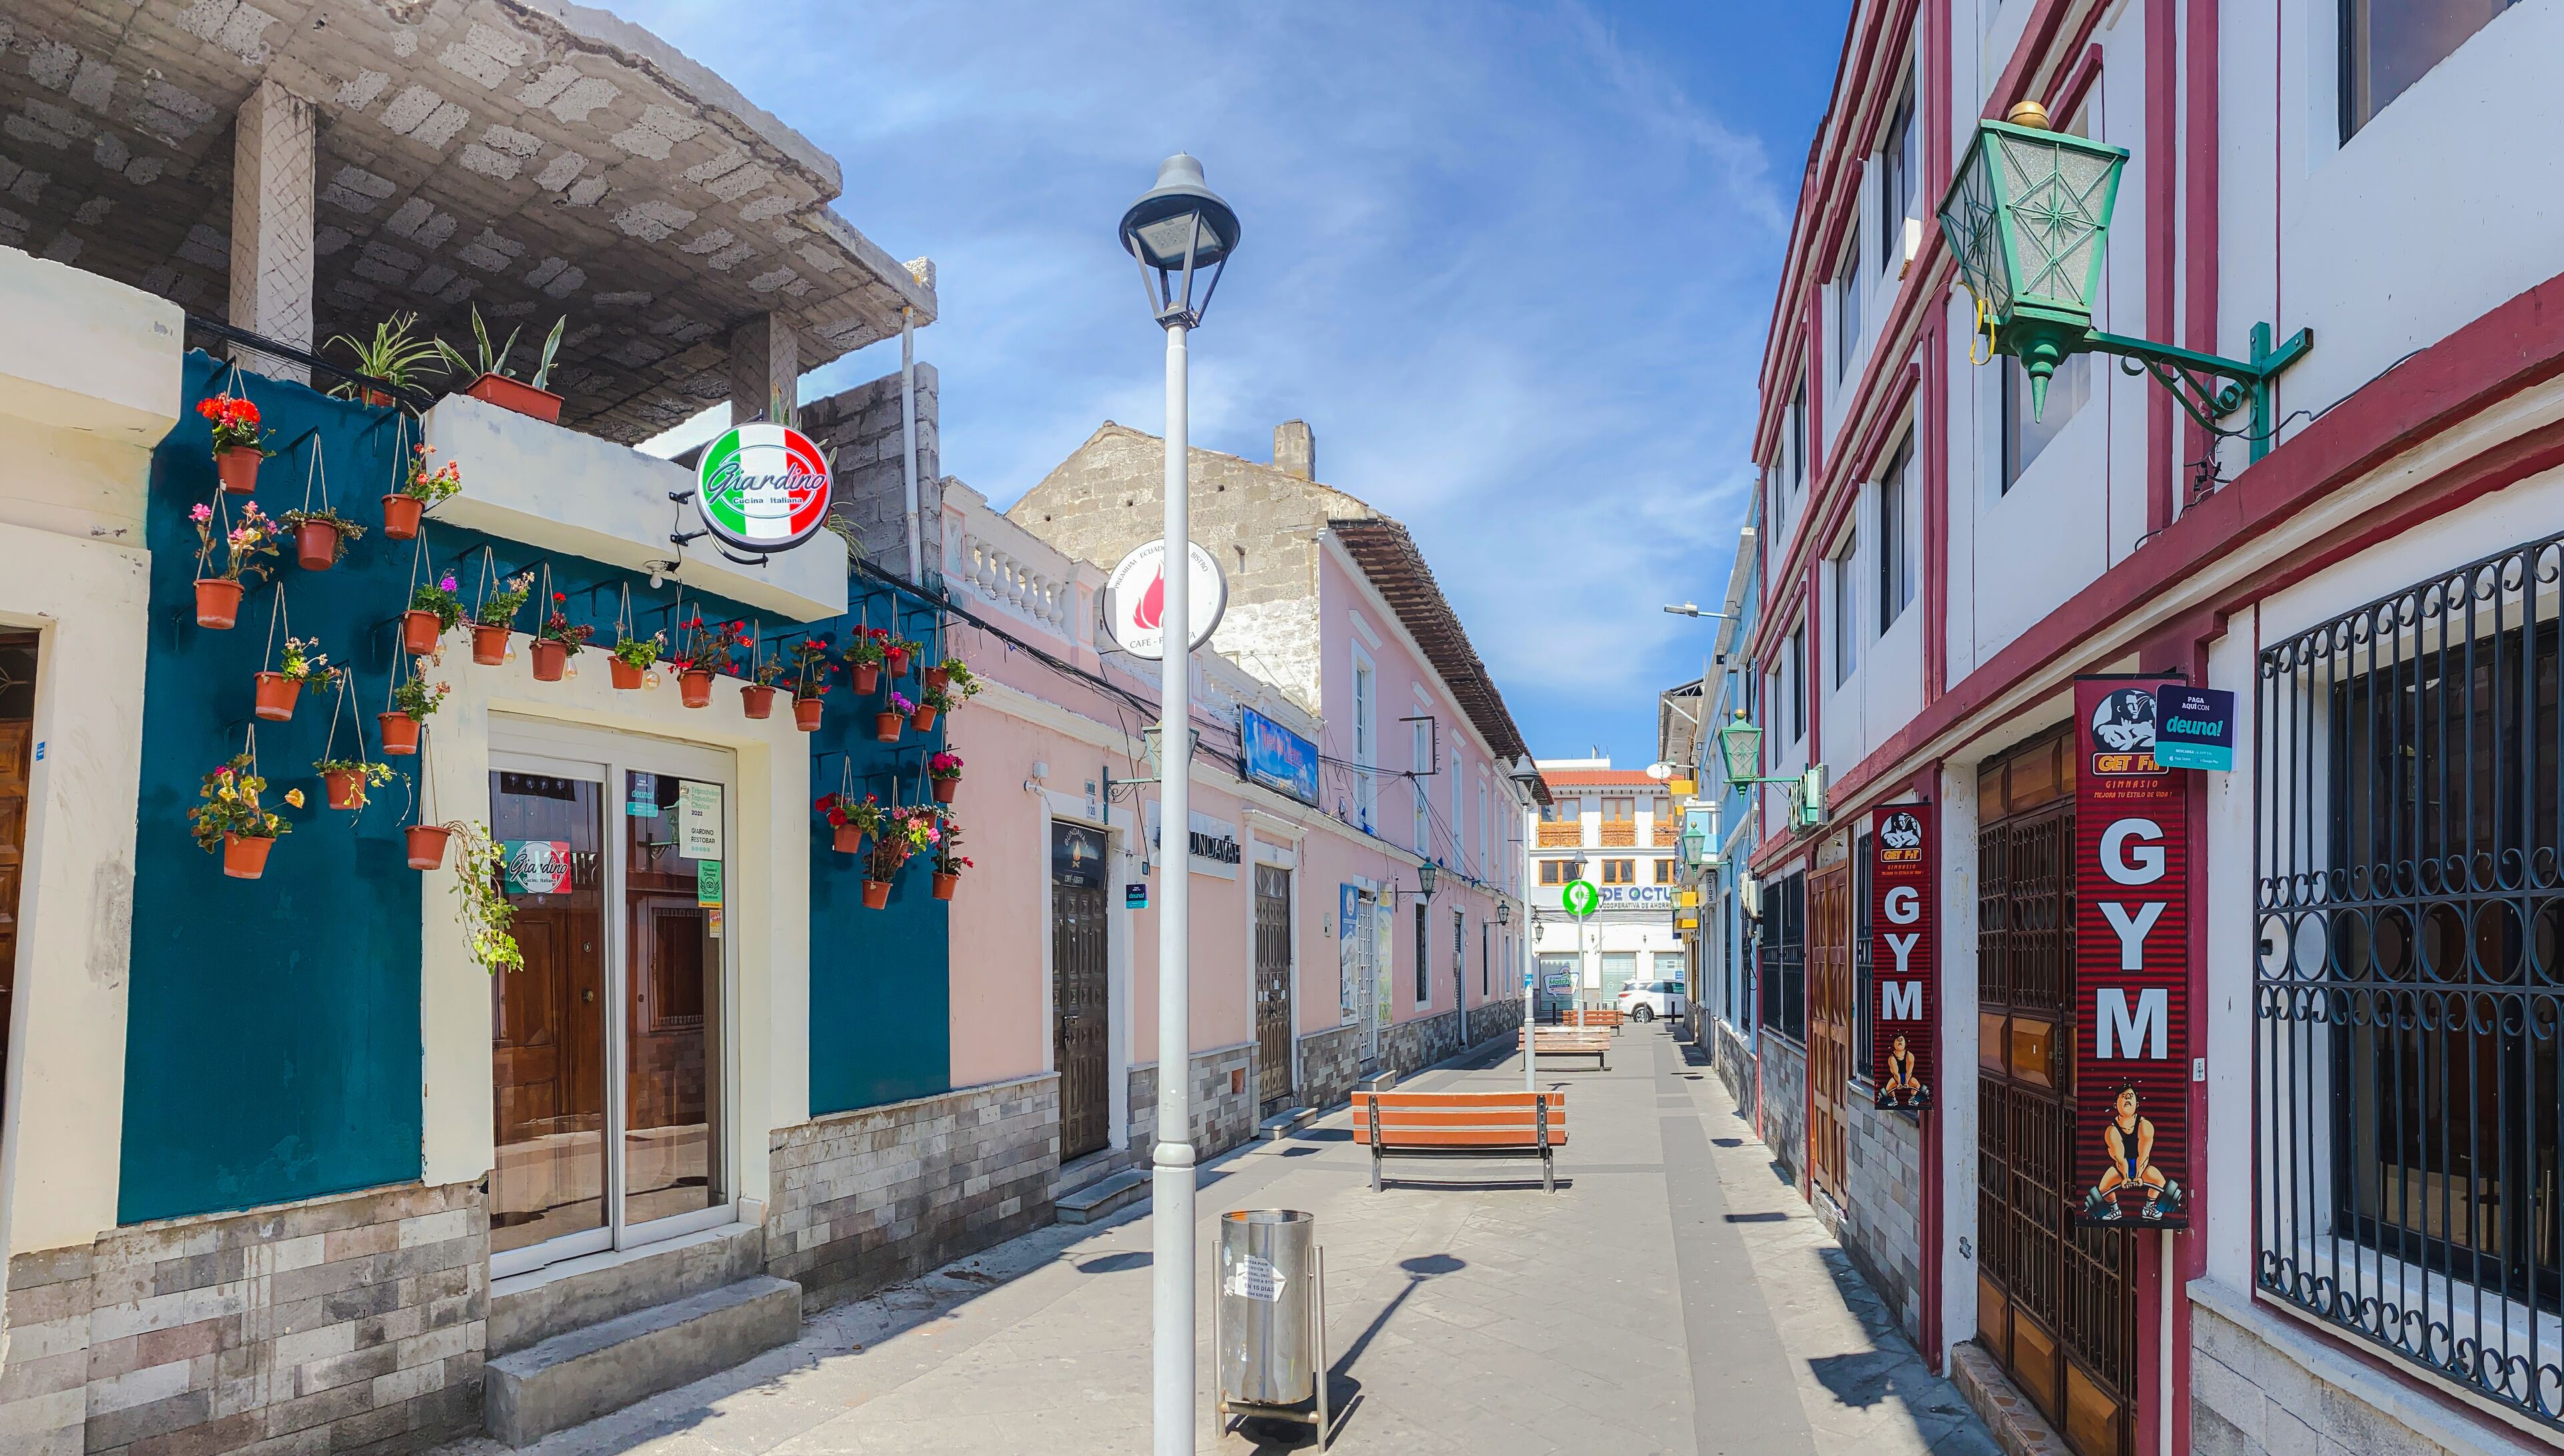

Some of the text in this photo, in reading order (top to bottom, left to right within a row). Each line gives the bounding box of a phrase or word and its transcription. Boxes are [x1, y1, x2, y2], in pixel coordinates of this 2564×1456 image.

[707, 461, 826, 503] Giardino
[1114, 559, 1137, 589] PREMIUM
[1191, 551, 1209, 572] BISTRO
[2166, 716, 2223, 737] deuna!
[2098, 755, 2133, 772] GET
[691, 787, 720, 796] Tripadvisor
[2105, 780, 2158, 788] GIMNASIO
[691, 802, 710, 810] Choice
[1884, 851, 1902, 860] GET
[2096, 818, 2168, 1060] GYM
[1882, 886, 1922, 1021] GYM
